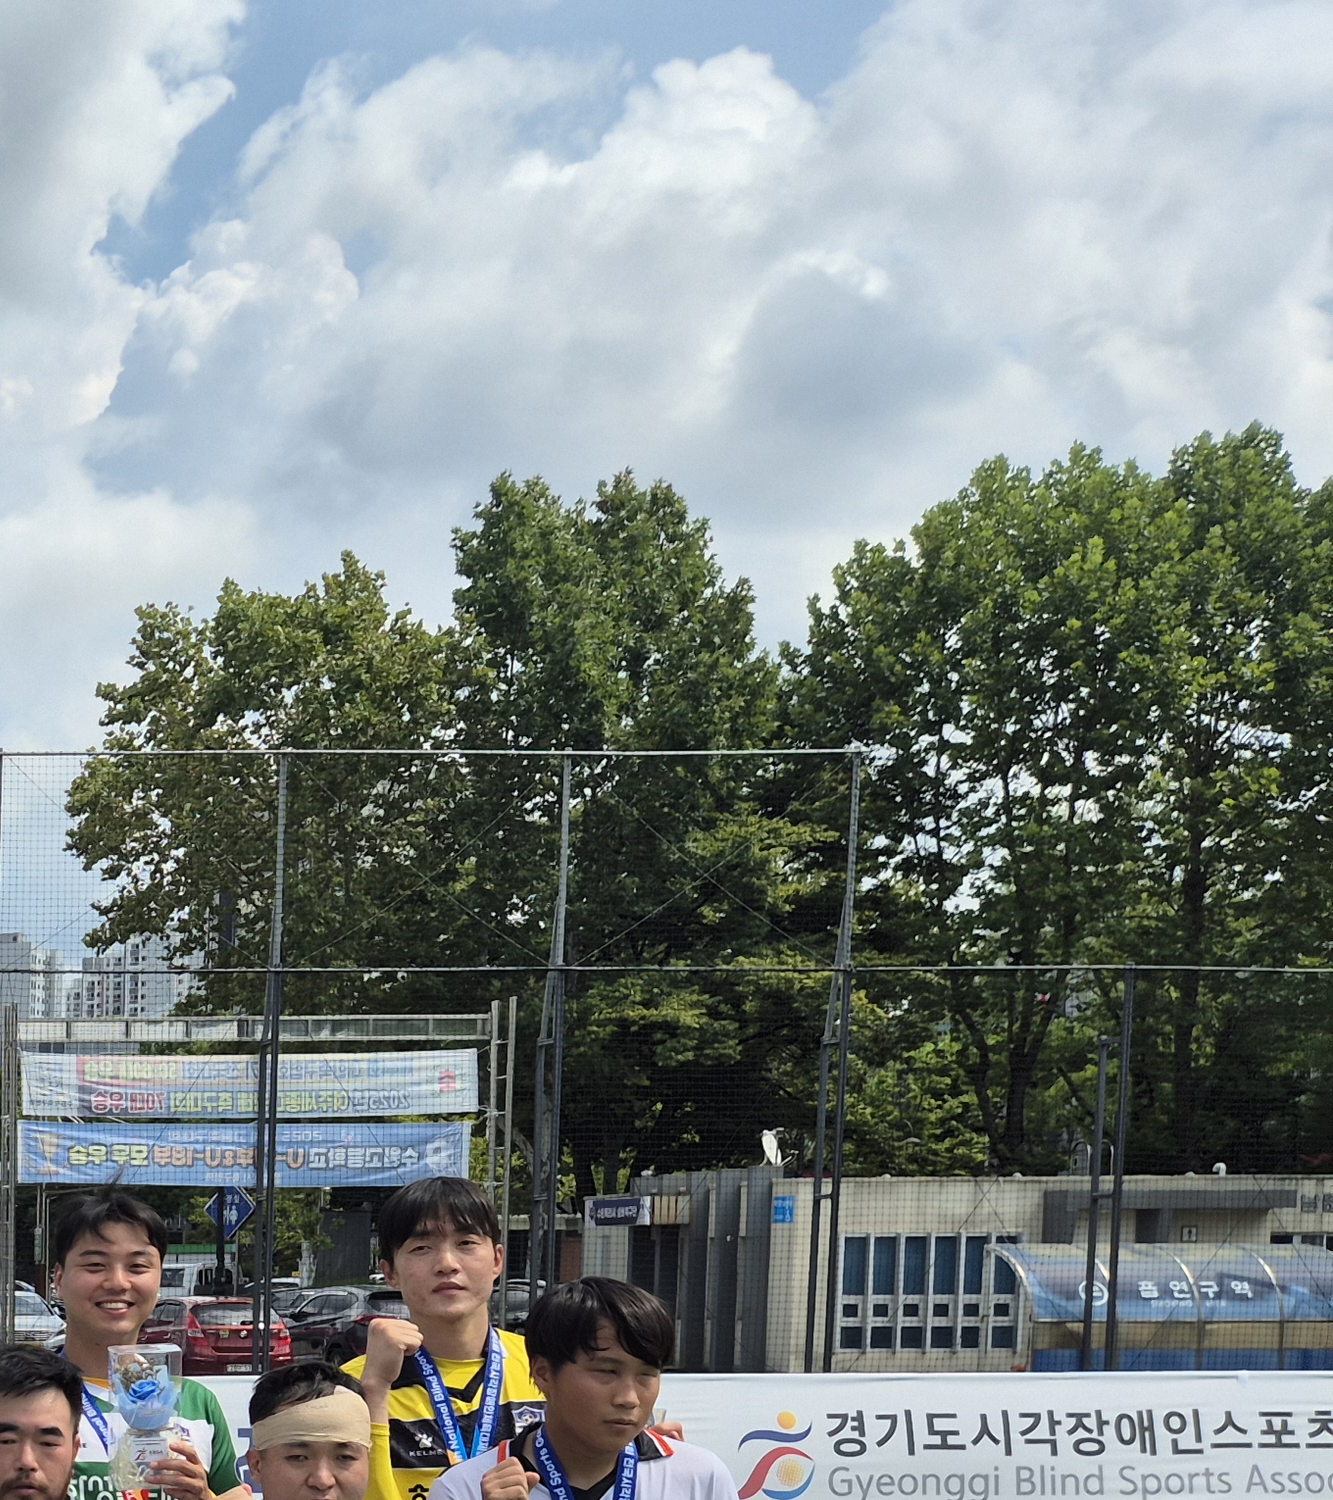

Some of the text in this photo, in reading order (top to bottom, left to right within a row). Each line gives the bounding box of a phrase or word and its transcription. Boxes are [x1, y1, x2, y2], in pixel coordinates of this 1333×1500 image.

[426, 1376, 460, 1451] National Blind
[824, 1408, 1333, 1458] 경기도시각장애인스포츠
[539, 1443, 562, 1487] Sports
[1016, 1463, 1105, 1498] Blind
